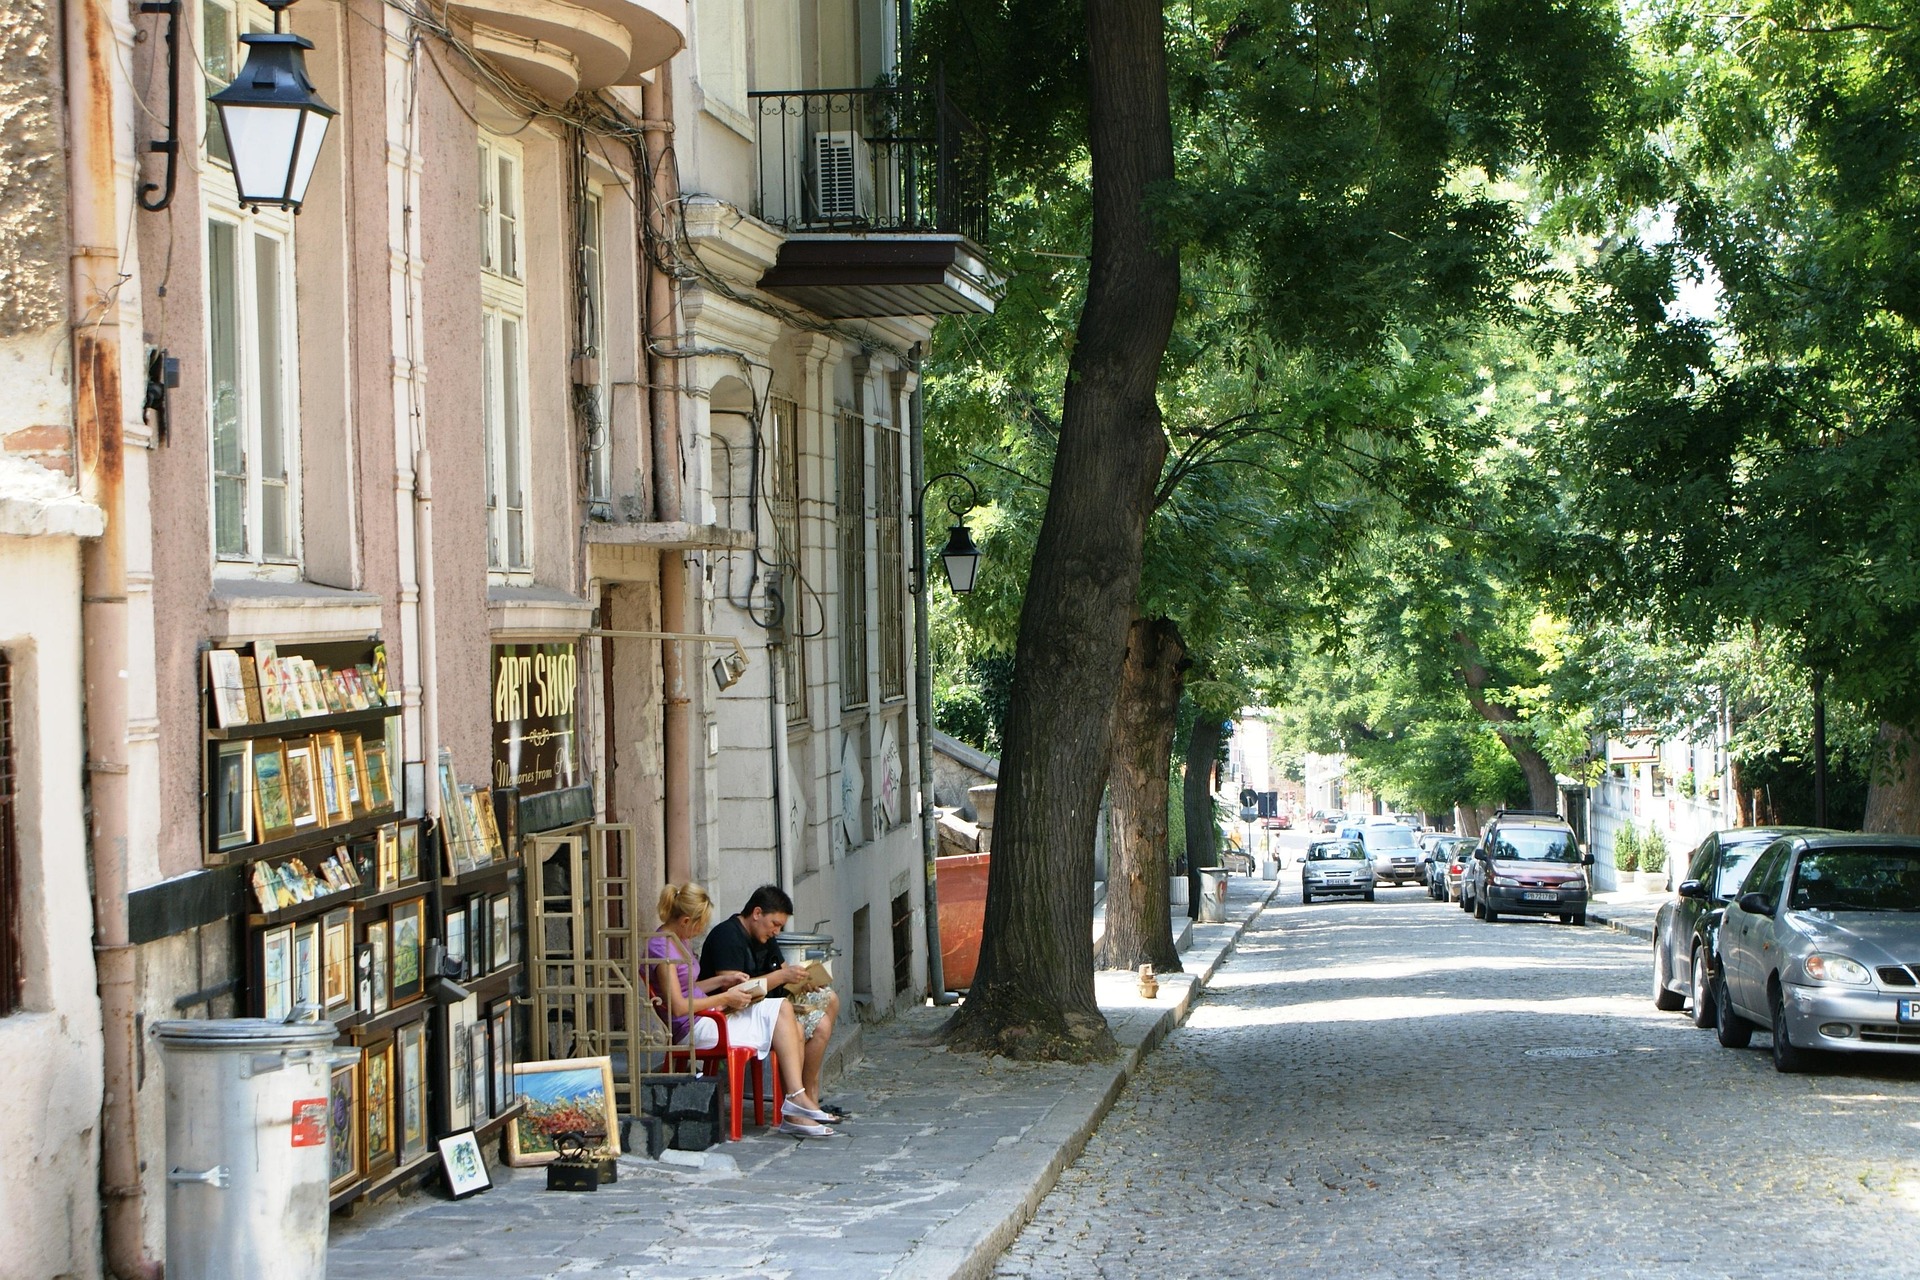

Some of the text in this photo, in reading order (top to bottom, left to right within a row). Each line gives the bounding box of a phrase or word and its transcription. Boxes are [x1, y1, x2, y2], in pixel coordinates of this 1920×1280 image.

[496, 653, 577, 723] ART SHOP
[534, 753, 553, 786] from
